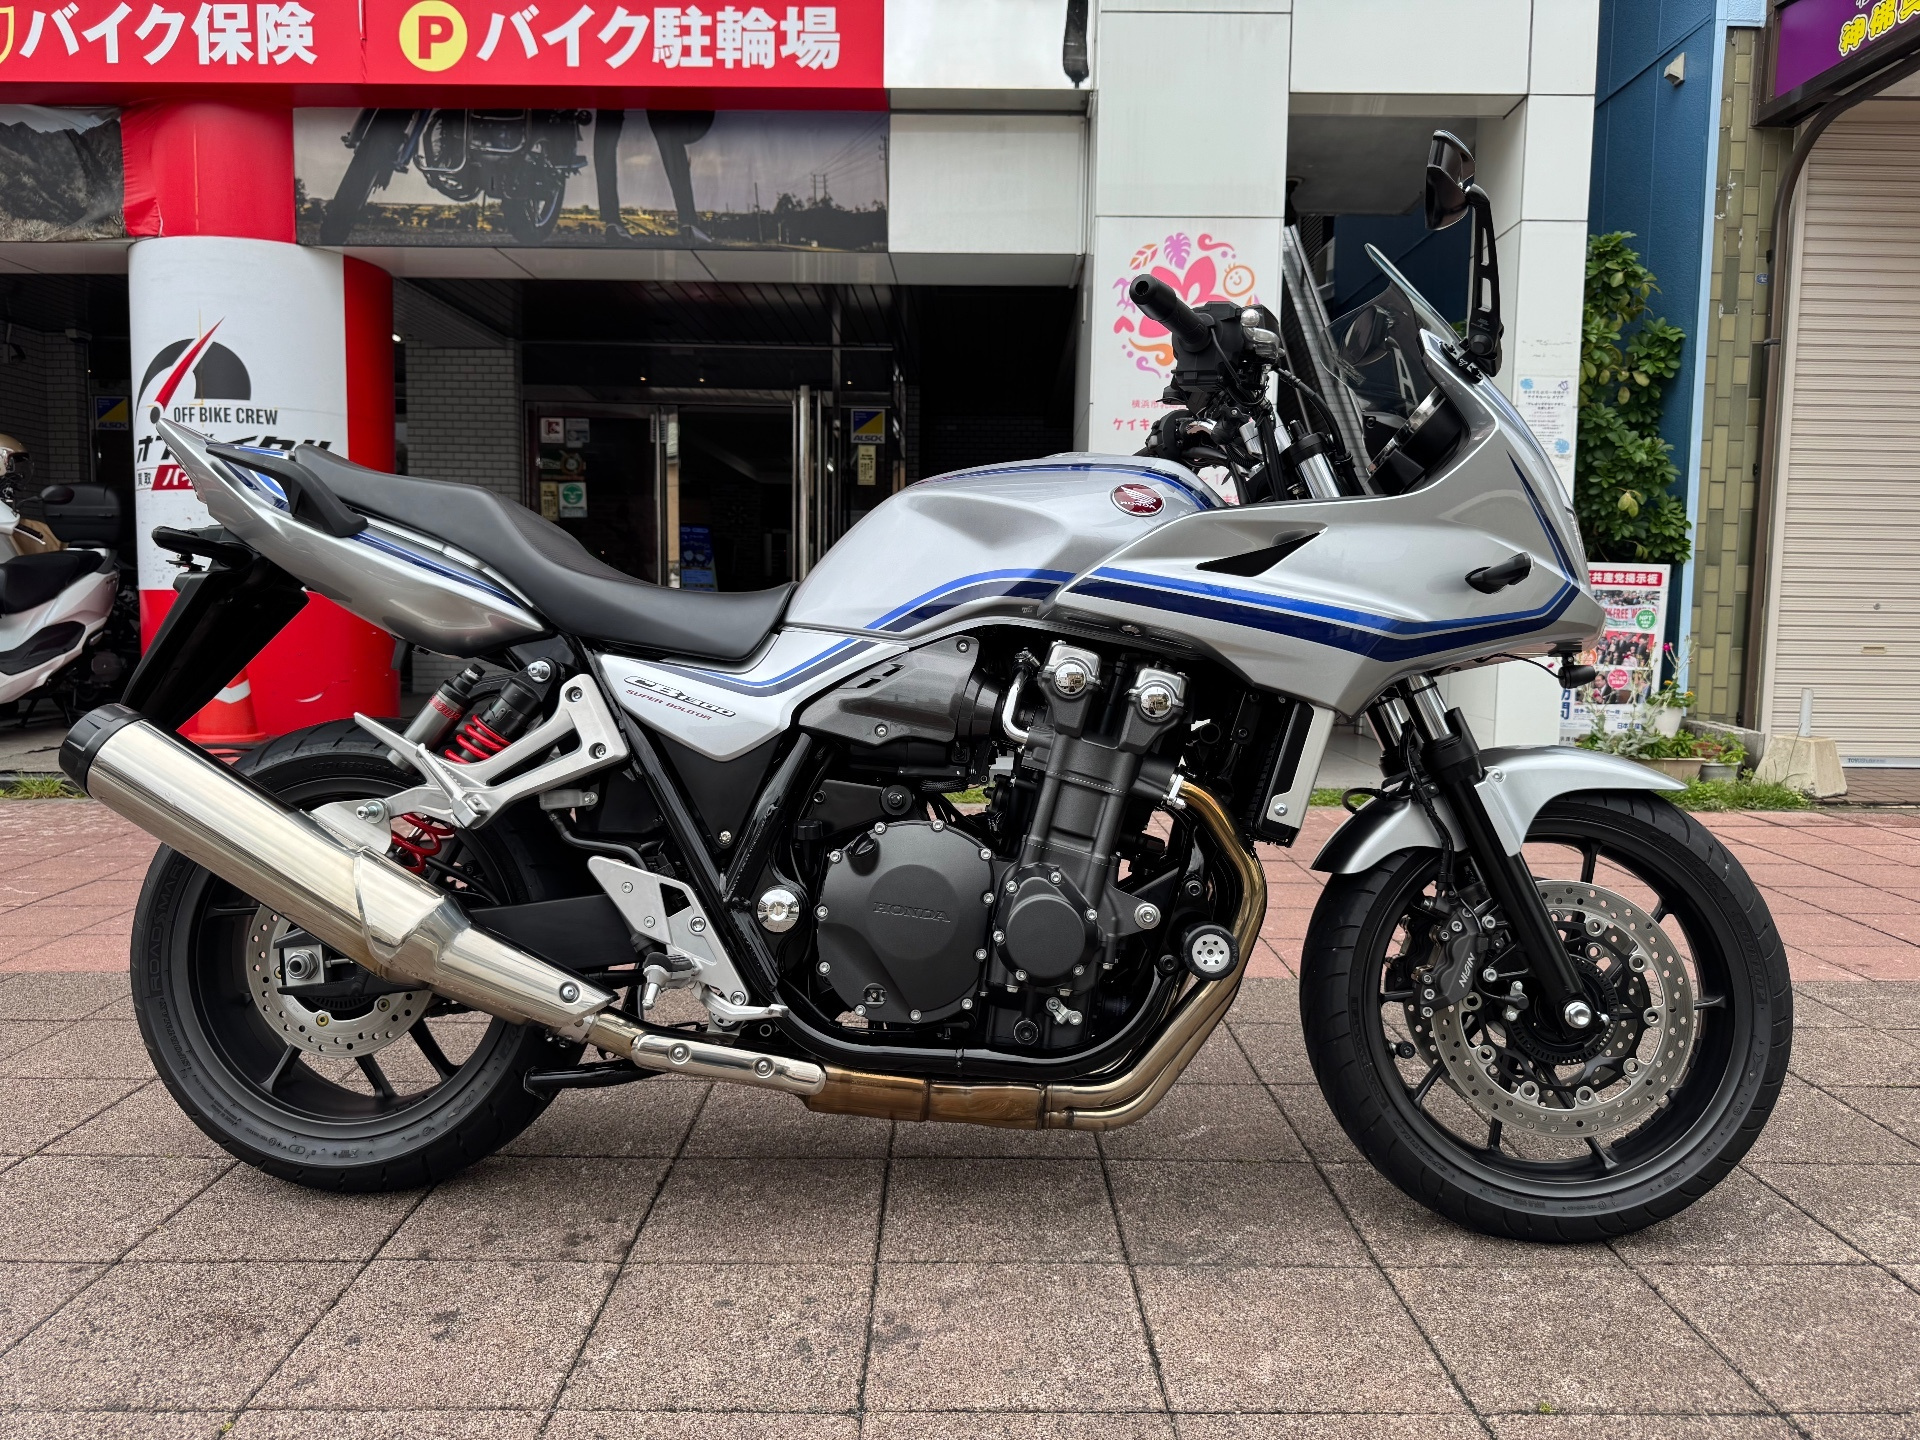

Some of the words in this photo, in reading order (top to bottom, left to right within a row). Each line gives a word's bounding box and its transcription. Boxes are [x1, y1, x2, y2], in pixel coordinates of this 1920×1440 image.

[19, 3, 317, 66] バイク保険
[477, 4, 840, 70] バイク駐輪場
[173, 407, 195, 423] OFF
[199, 407, 231, 423] BIKE
[236, 407, 278, 425] CREW
[1589, 571, 1659, 585] 共産党掲示板
[626, 689, 663, 704] SUPER
[873, 902, 951, 923] HONDA
[1458, 952, 1477, 988] NISSIN
